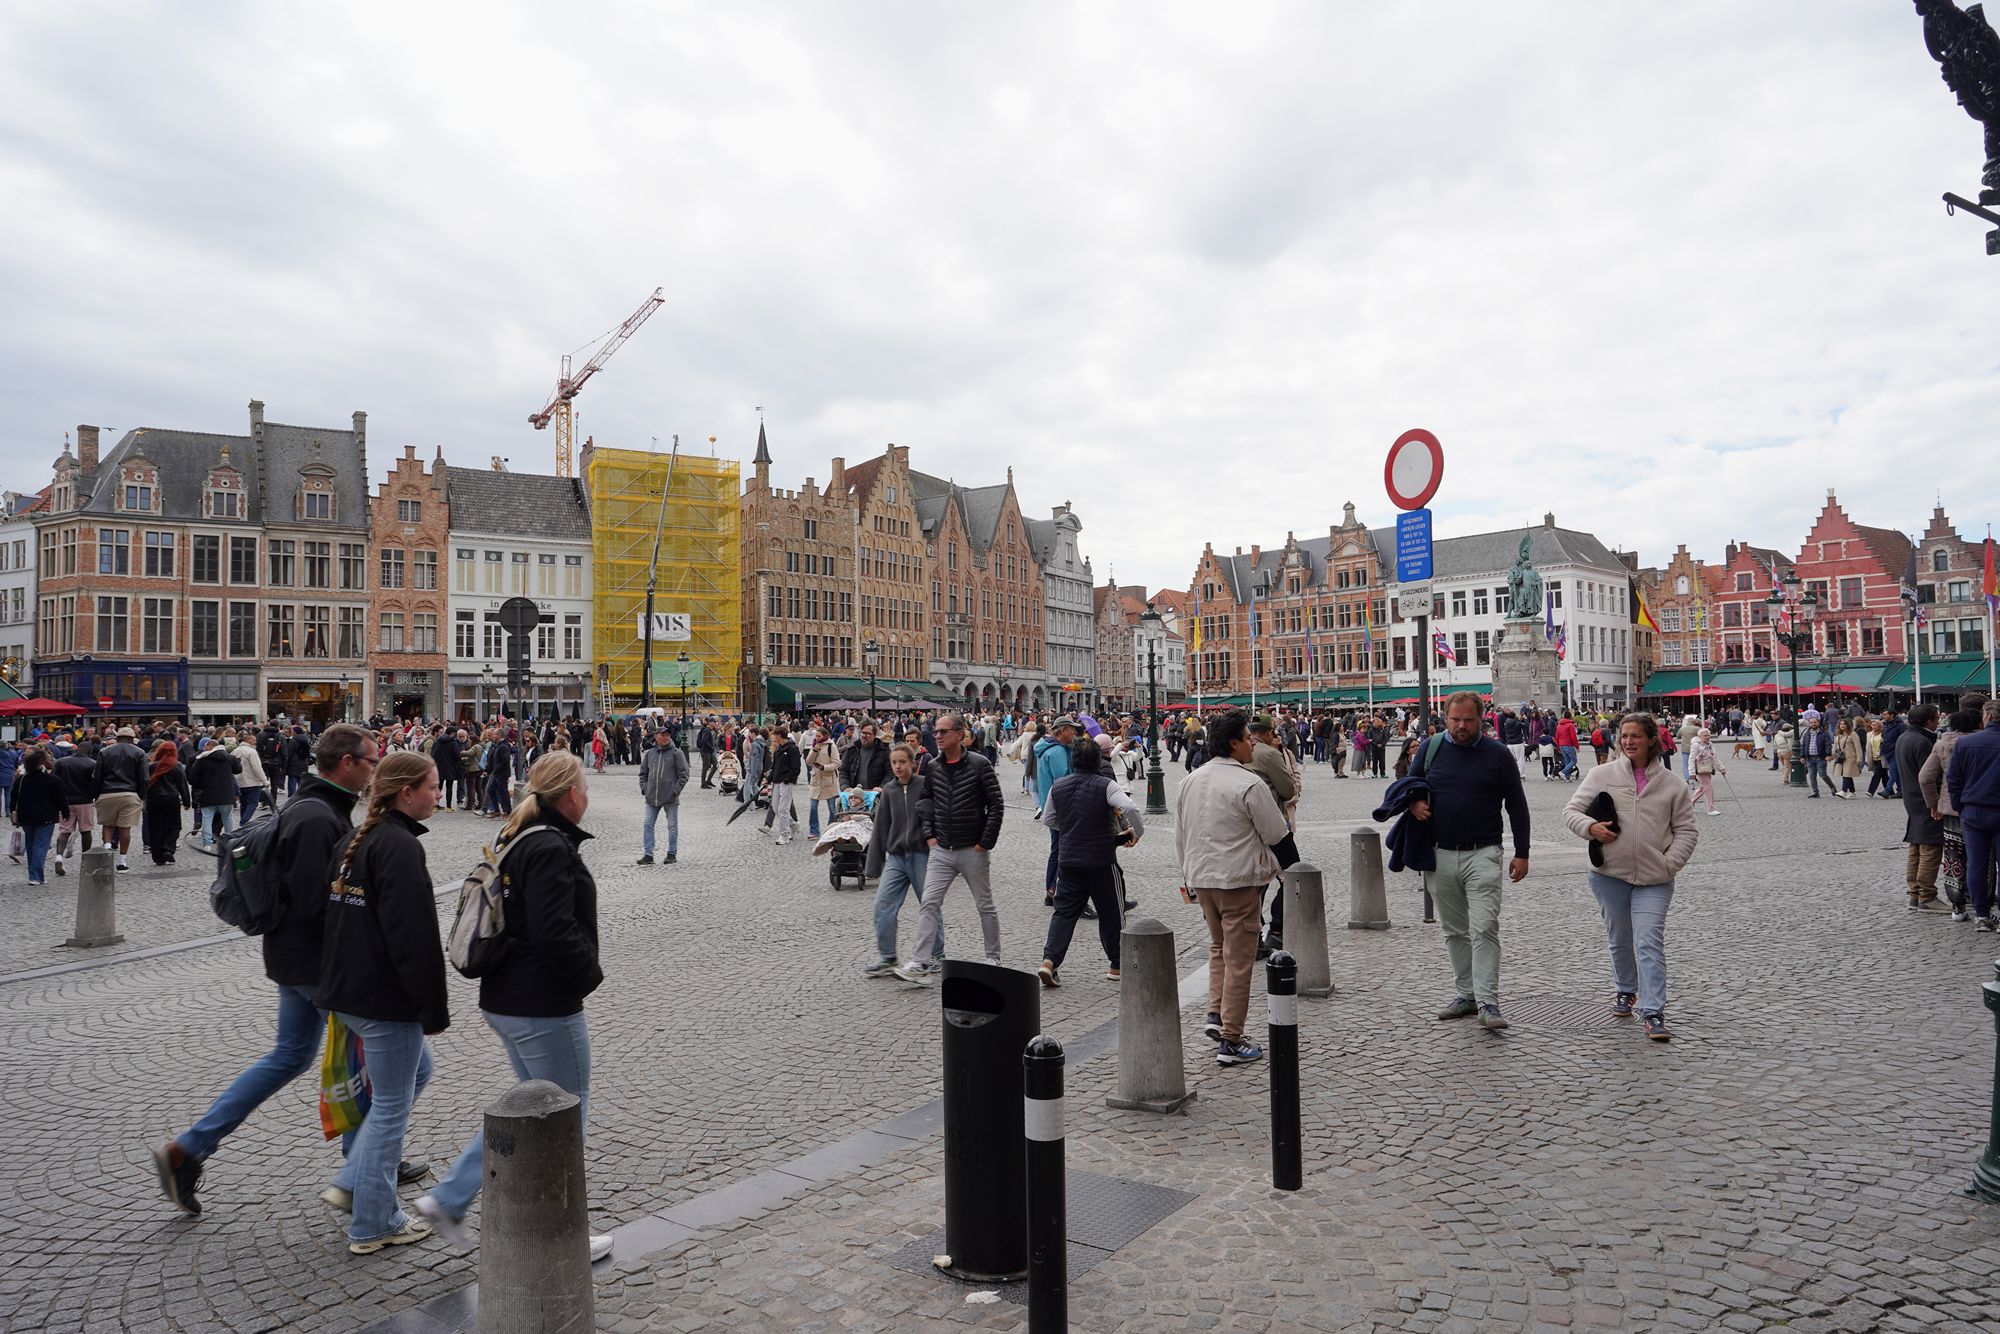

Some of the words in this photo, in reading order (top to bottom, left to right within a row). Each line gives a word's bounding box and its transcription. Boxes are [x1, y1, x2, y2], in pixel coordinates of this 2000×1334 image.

[1399, 586, 1429, 596] UITGEZONDERD
[396, 676, 433, 685] BRUGGE
[548, 676, 564, 684] 1954
